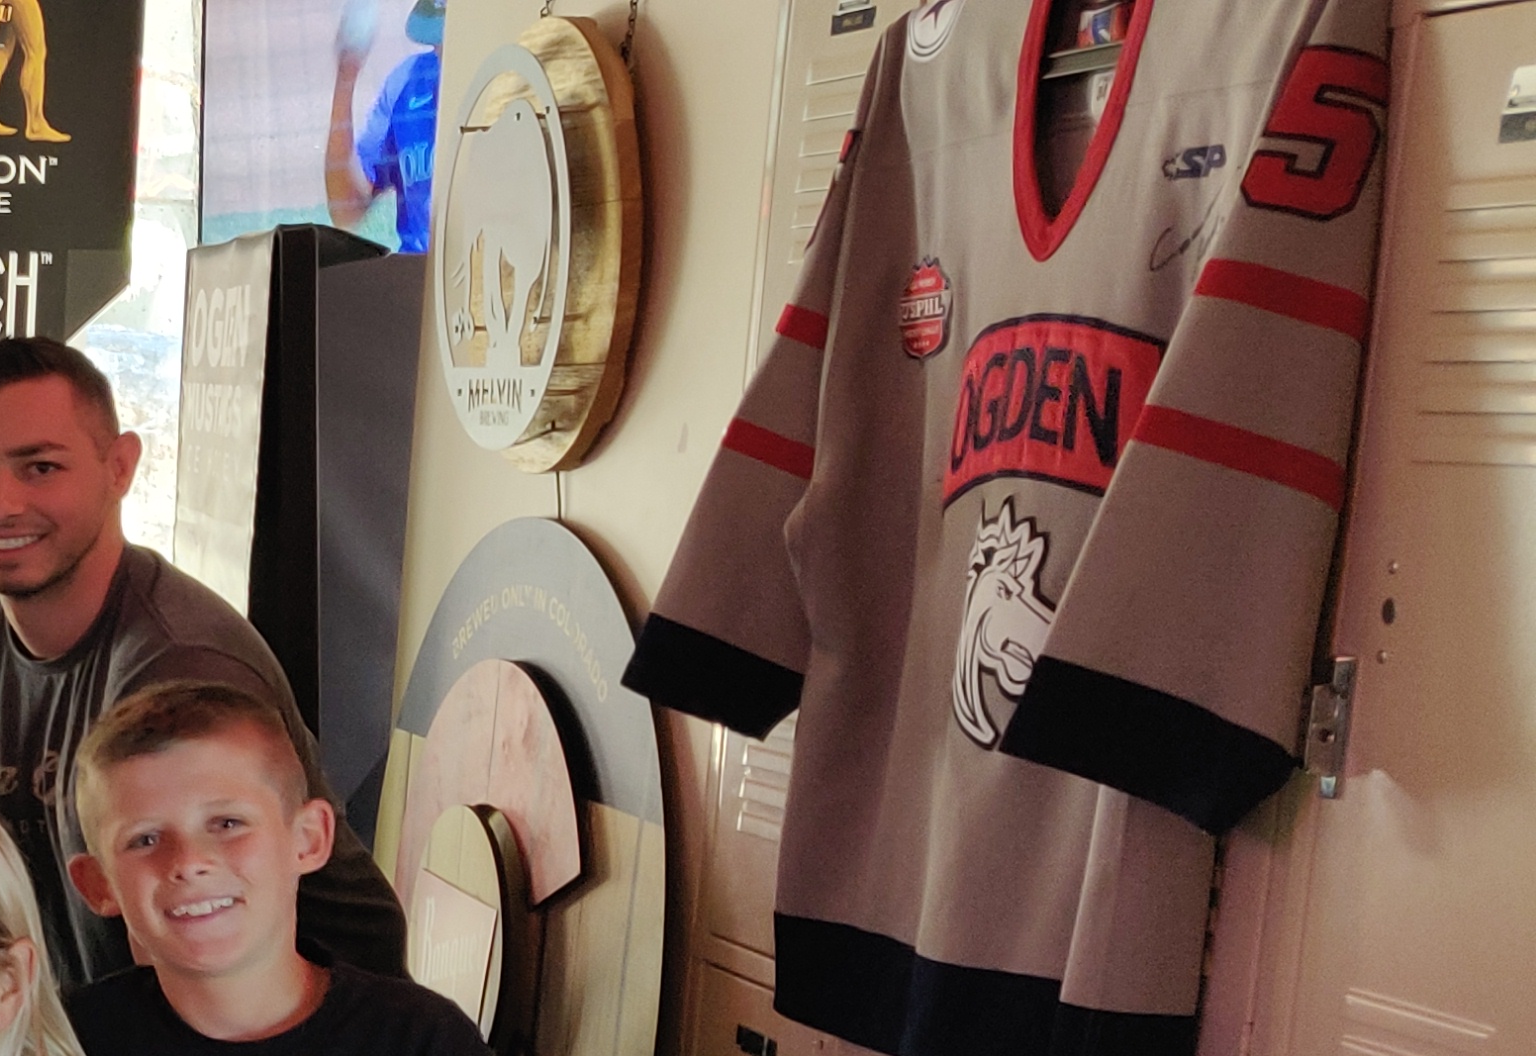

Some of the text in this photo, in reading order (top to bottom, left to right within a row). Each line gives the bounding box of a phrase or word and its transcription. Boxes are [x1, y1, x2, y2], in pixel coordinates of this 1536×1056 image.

[1239, 44, 1391, 222] 5
[468, 378, 523, 415] MELVIN
[950, 346, 1123, 475] OGDEN
[452, 594, 501, 660] BREWED
[501, 584, 532, 609] ONLY
[533, 586, 548, 613] IN
